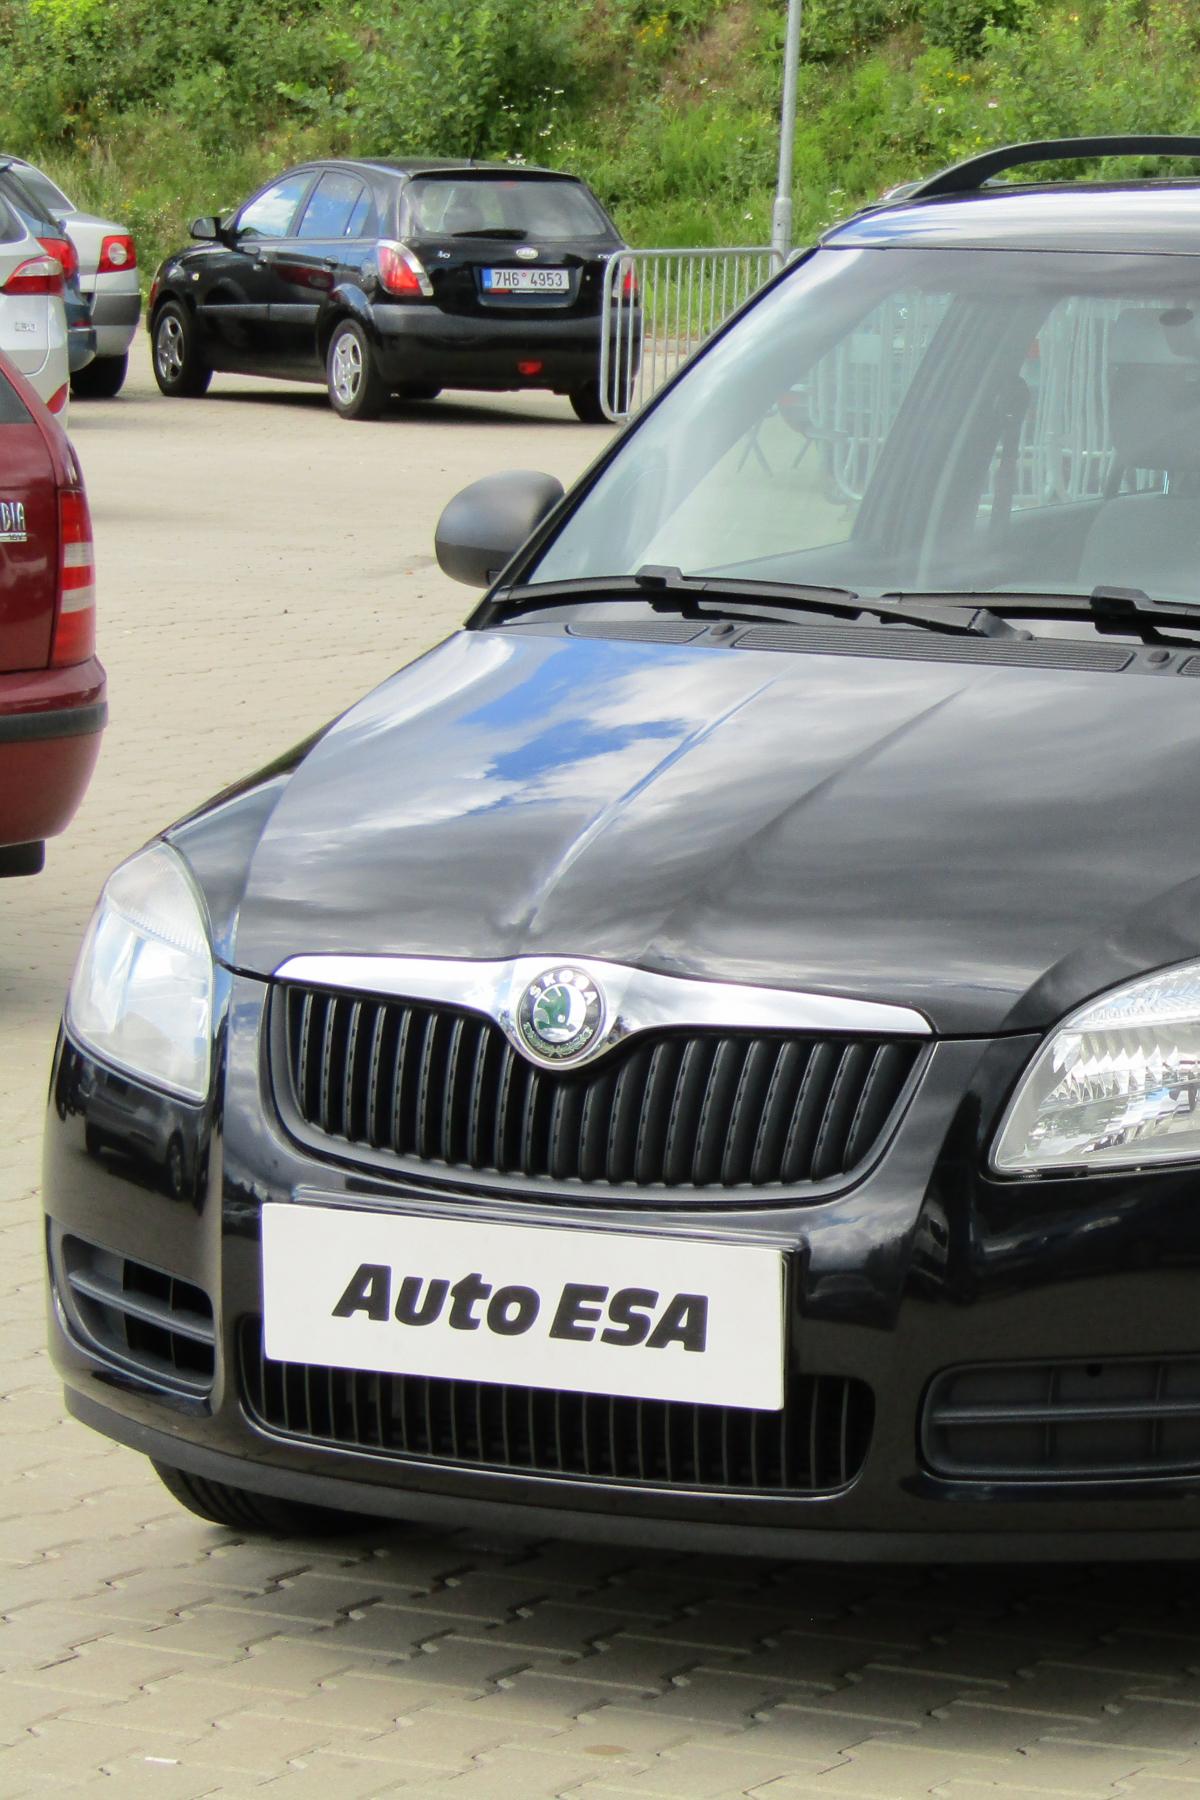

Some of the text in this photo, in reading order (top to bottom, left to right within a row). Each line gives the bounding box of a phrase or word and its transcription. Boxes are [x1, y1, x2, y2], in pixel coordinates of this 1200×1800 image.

[495, 271, 563, 287] 7H6 4953
[0, 502, 26, 531] BIA
[332, 1263, 708, 1352] Auto ESA
